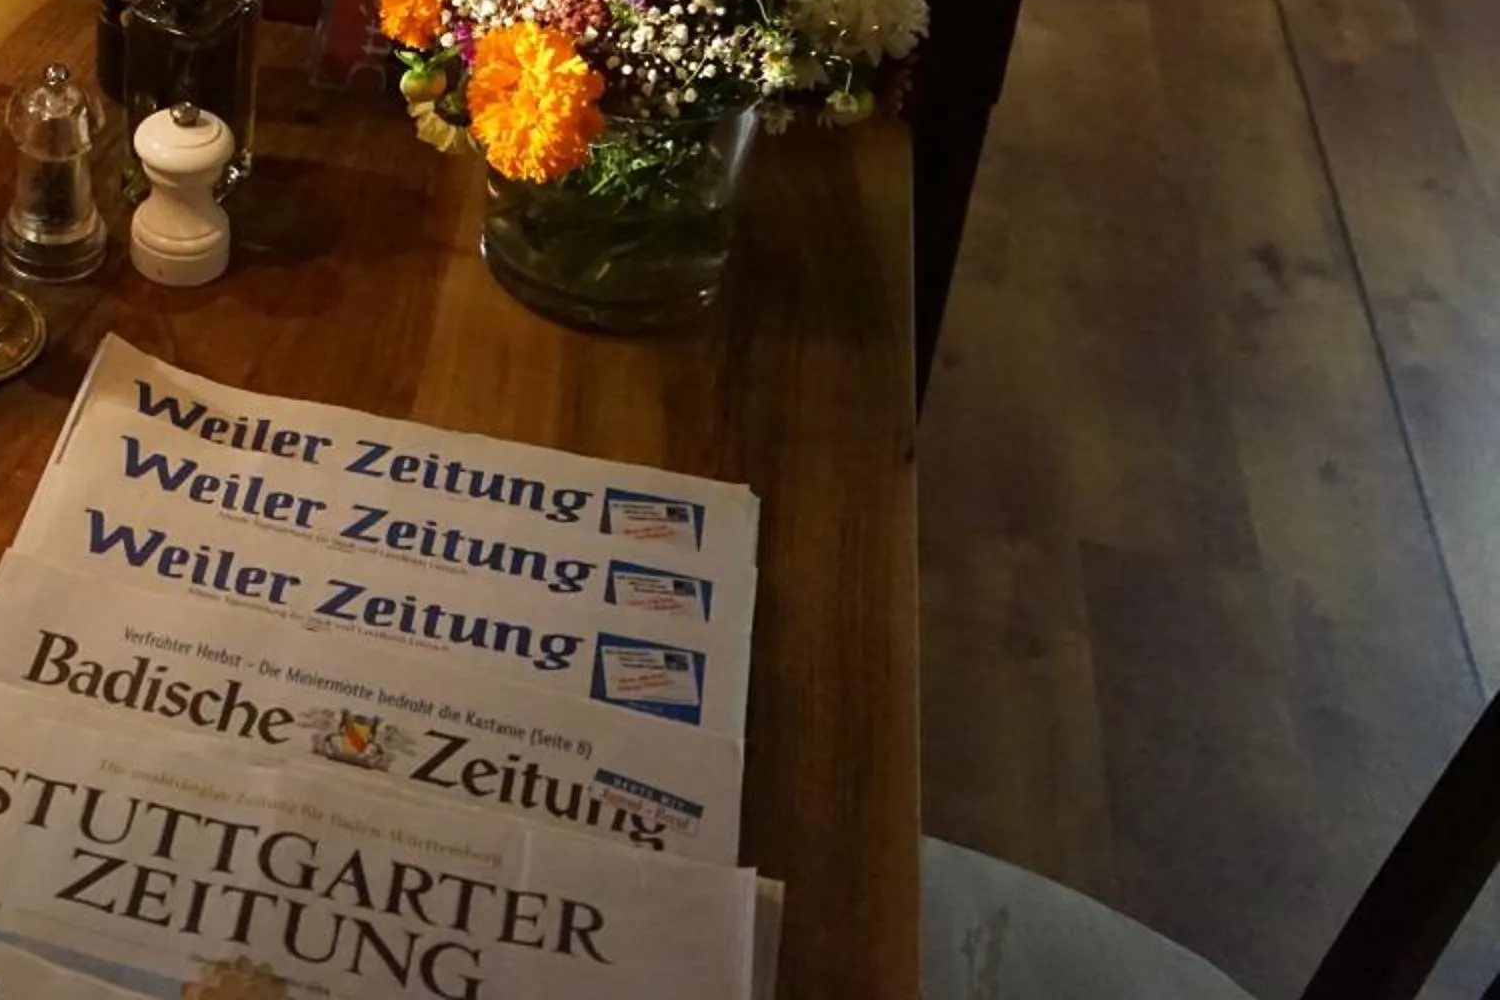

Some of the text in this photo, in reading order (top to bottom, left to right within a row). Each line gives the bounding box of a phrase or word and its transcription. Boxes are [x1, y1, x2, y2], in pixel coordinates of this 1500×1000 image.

[120, 435, 326, 529] Weiler
[338, 504, 598, 594] Zeitung
[134, 380, 333, 465] Weiler
[344, 440, 595, 523] Zeitung
[85, 508, 301, 605] Weiler
[314, 579, 586, 671] Zeitung
[20, 629, 665, 851] Badische Zeitung
[124, 625, 192, 657] Verfrühter
[197, 643, 243, 668] Herbst
[258, 660, 283, 679] Die
[284, 666, 375, 700] Miniermotte
[378, 688, 434, 717] bedroht
[438, 704, 461, 723] die
[464, 711, 527, 740] Kastanie
[529, 728, 574, 752] (Seite
[575, 740, 595, 760] 8)
[55, 848, 485, 1000] ZEITUNG
